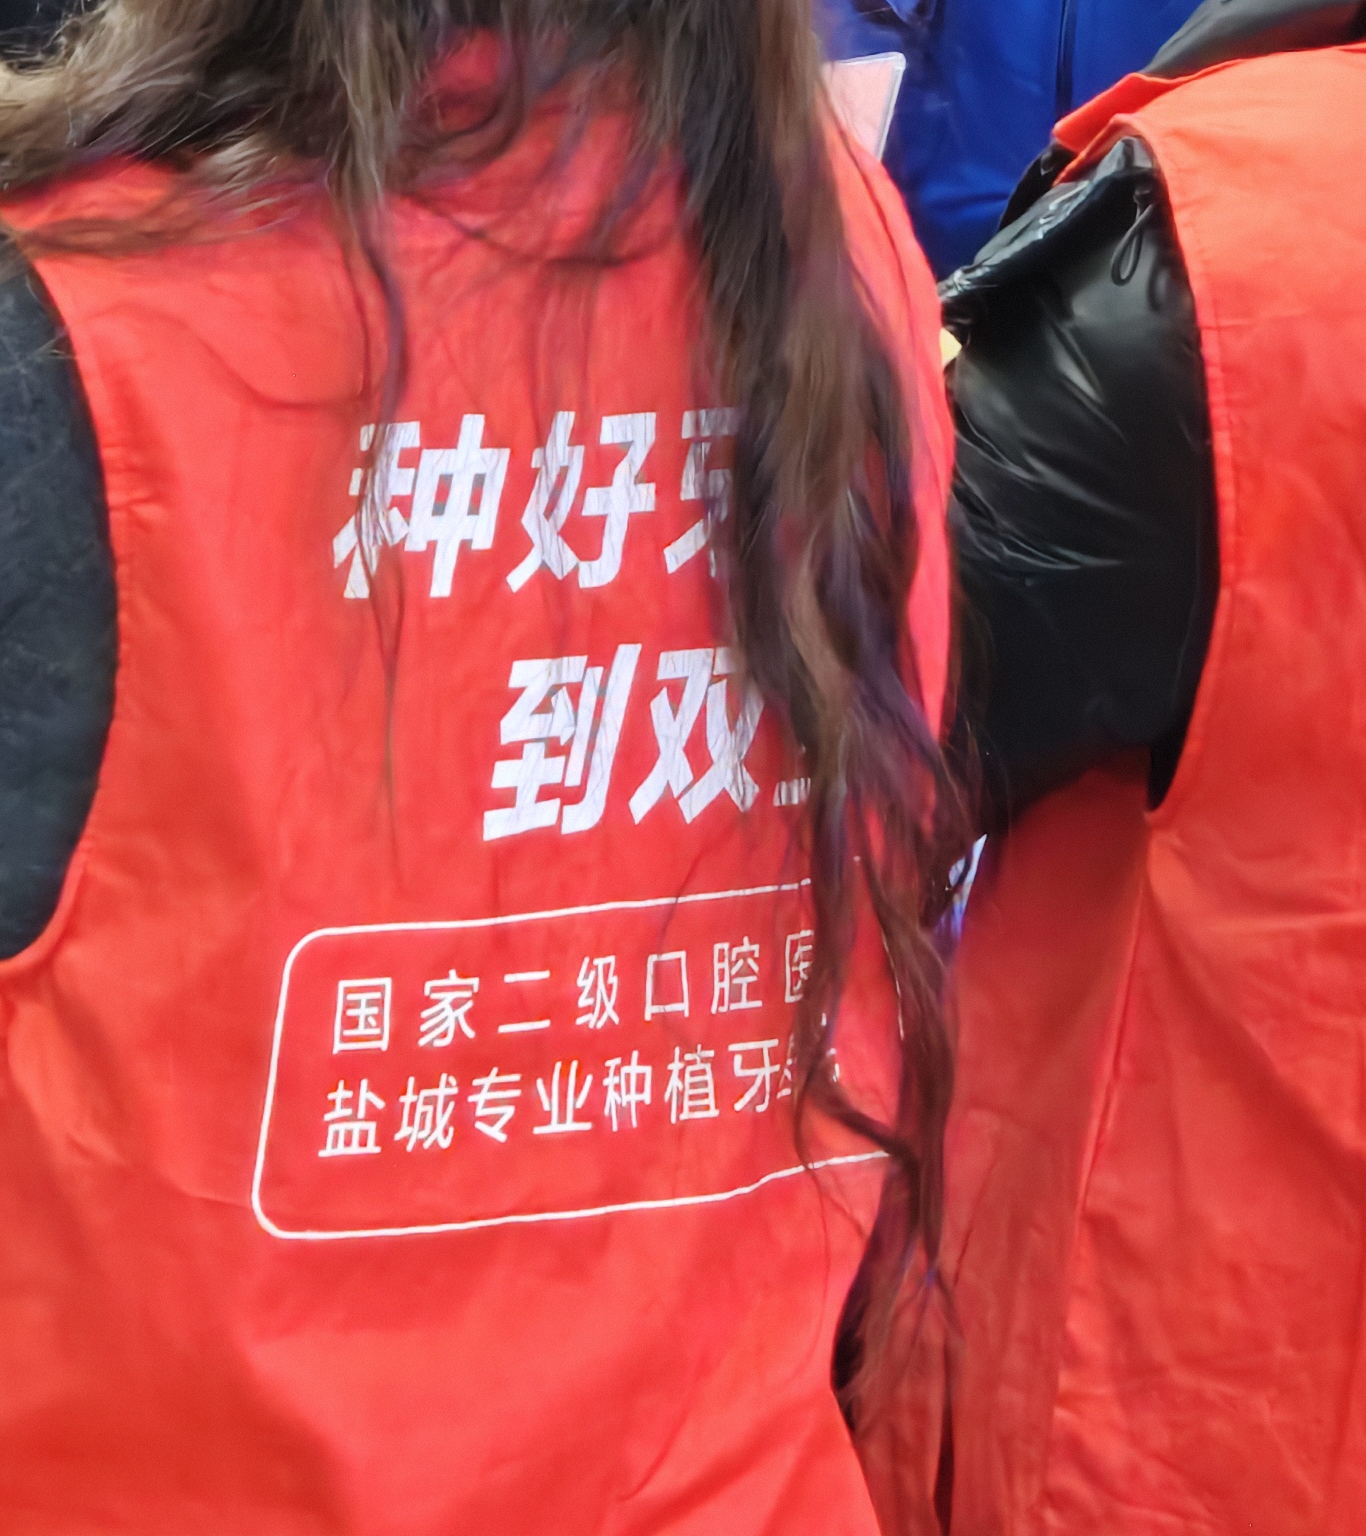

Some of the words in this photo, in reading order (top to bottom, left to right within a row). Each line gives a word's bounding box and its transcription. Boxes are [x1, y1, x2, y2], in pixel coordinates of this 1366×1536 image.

[483, 643, 811, 841] 到双
[332, 929, 817, 1054] 国家二级口腔医
[318, 1037, 839, 1157] 盐城专业种植牙
